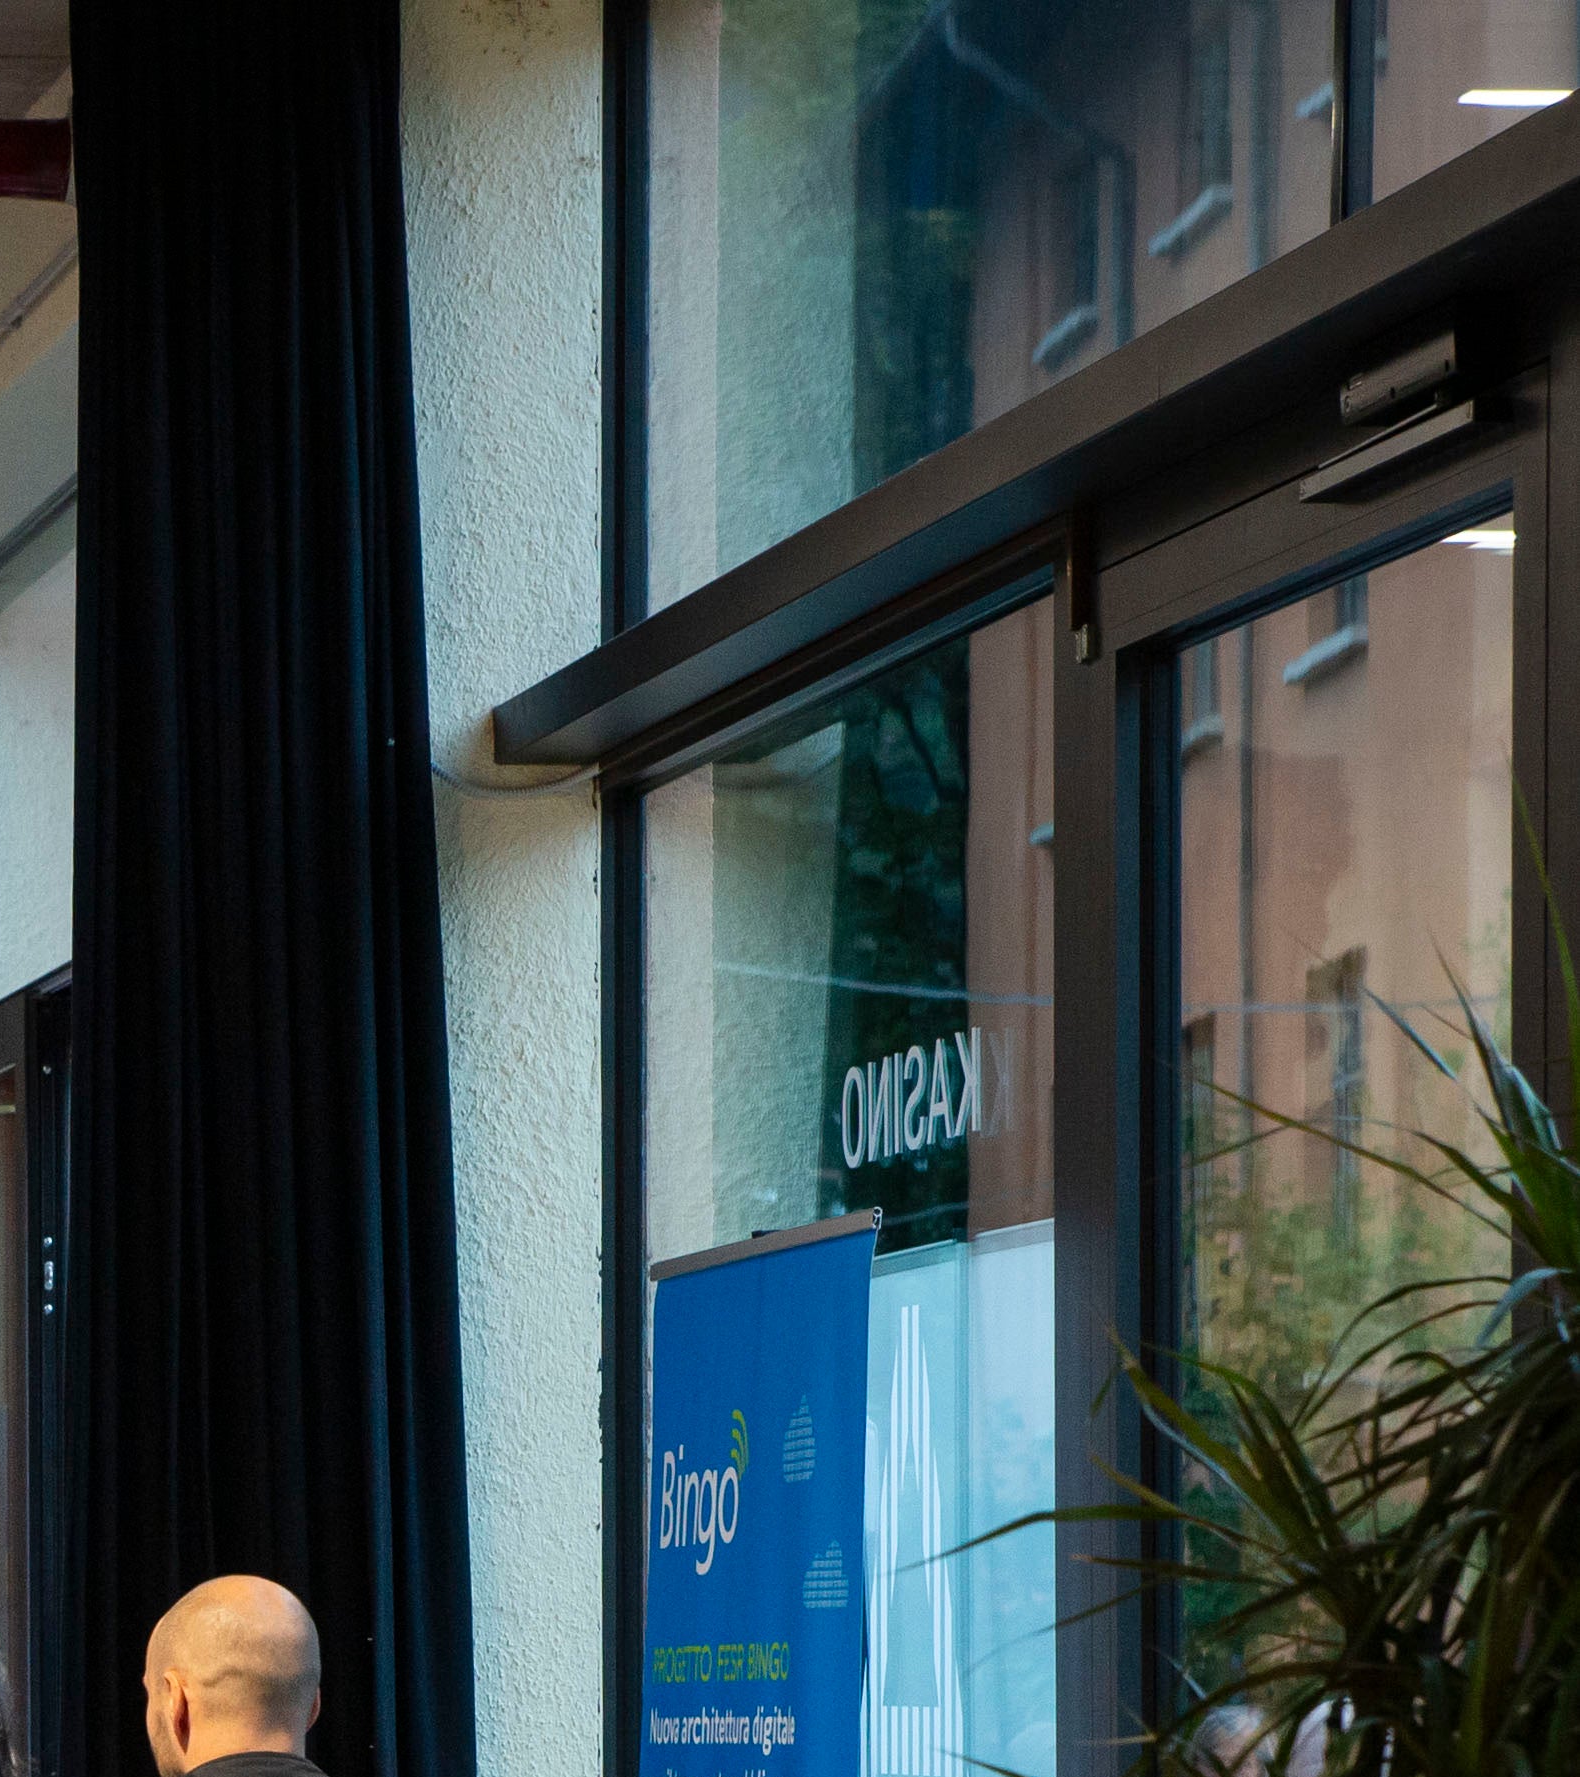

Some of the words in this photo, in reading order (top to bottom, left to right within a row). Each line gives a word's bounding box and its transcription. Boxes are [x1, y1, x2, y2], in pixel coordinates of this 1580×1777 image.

[659, 1443, 739, 1576] Bingo
[652, 1644, 713, 1684] PROGETTO
[747, 1641, 790, 1681] BINGO
[649, 1706, 679, 1744] Nuova
[681, 1706, 750, 1744] architettura
[752, 1705, 796, 1756] digitale
